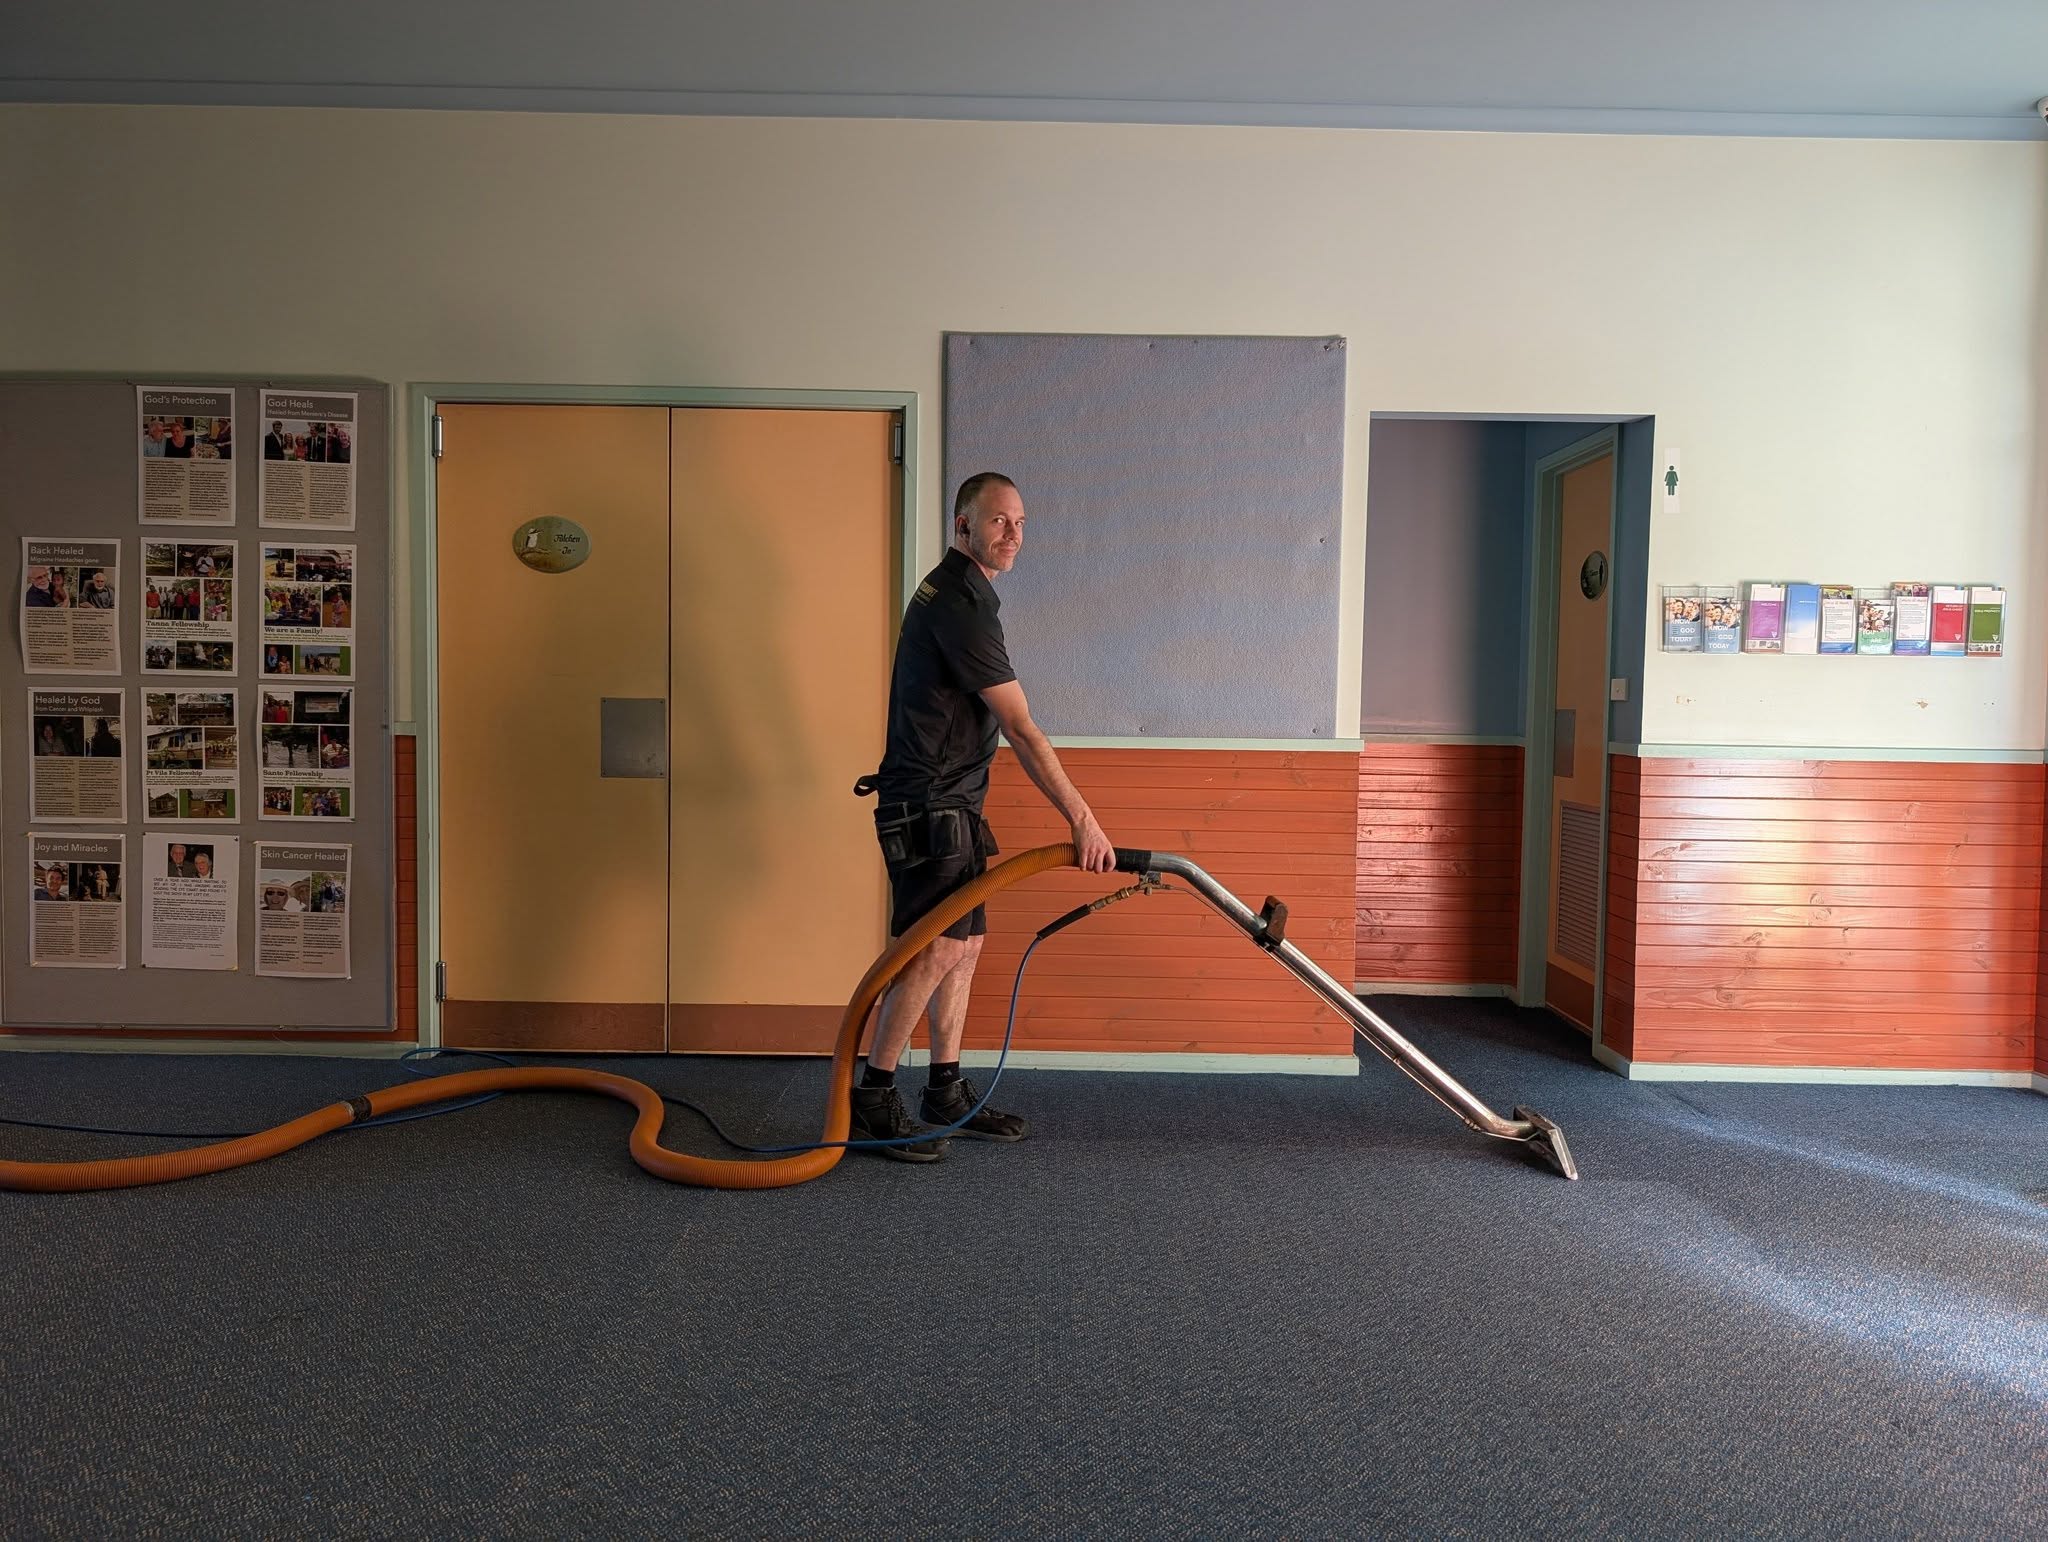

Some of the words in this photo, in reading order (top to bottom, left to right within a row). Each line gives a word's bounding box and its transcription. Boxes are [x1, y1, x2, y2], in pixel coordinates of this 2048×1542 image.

[144, 394, 170, 404] God's
[172, 395, 217, 405] Protection
[267, 398, 287, 408] God
[289, 399, 314, 409] Heals
[30, 546, 51, 555] Back
[53, 546, 84, 555] Healed
[171, 621, 210, 629] Fellowship
[296, 627, 323, 635] Family!
[35, 695, 66, 704] Healed
[67, 695, 79, 706] by
[80, 696, 101, 705] God
[78, 706, 104, 714] Whiplash
[263, 769, 284, 777] Santo
[285, 770, 324, 779] Fellowship
[35, 842, 51, 853] Joy
[52, 843, 69, 852] and
[71, 843, 108, 853] Miracles
[262, 849, 280, 858] Skin
[282, 850, 313, 860] Cancer
[315, 851, 346, 861] Healed
